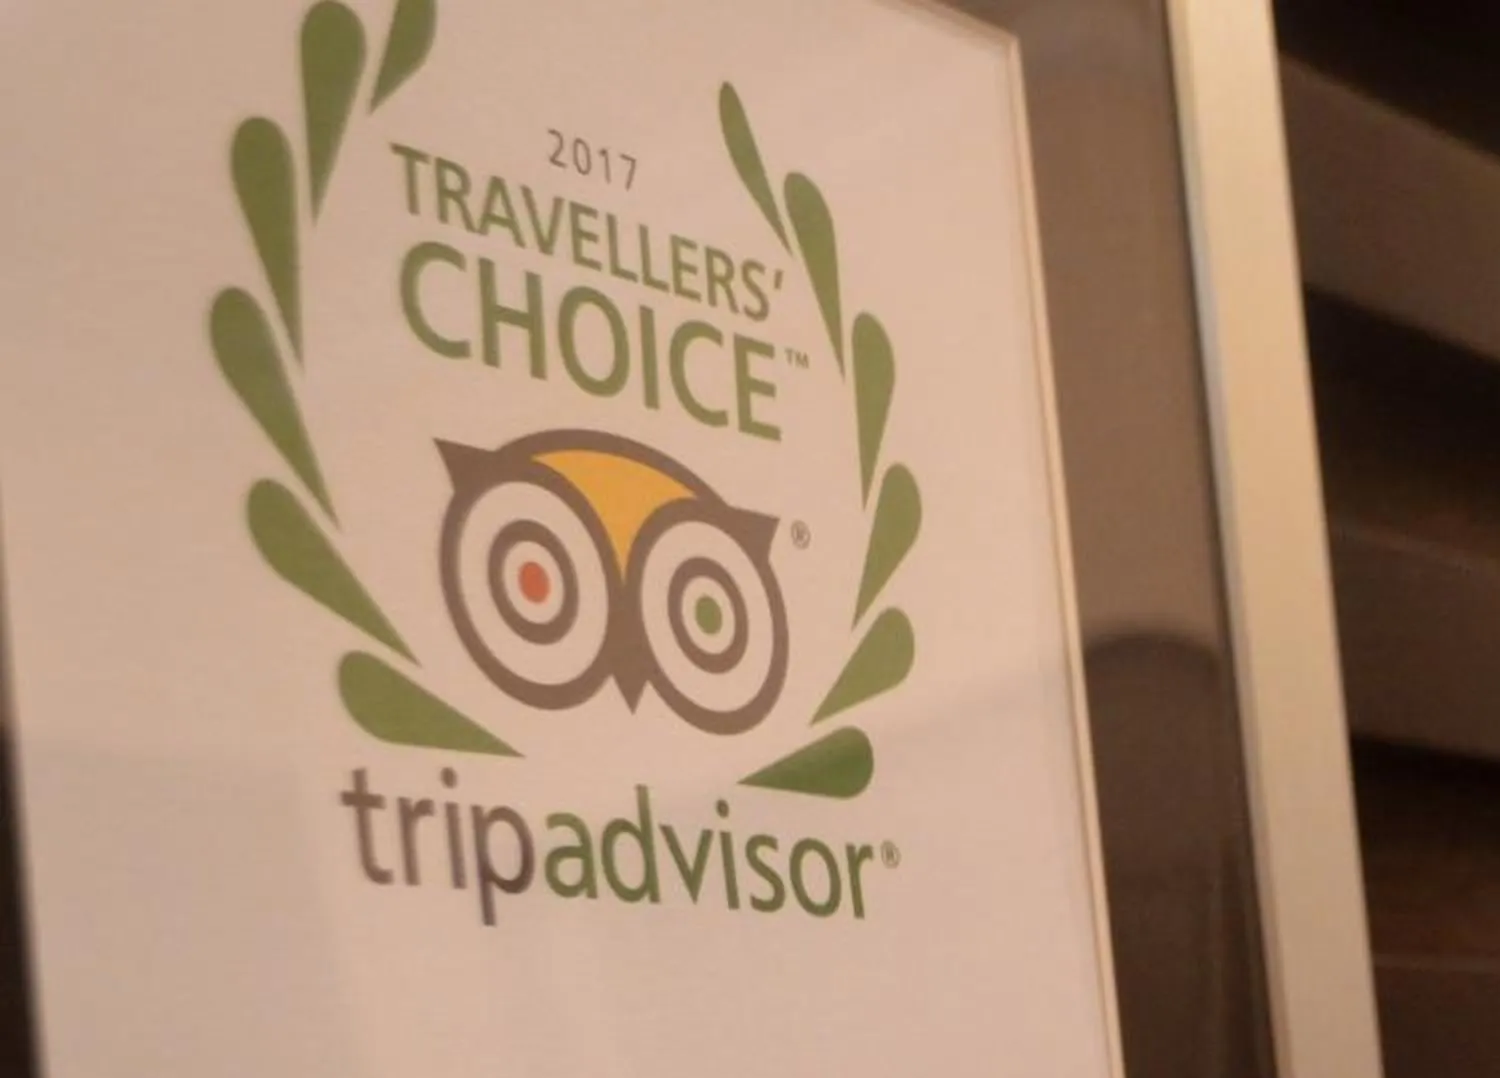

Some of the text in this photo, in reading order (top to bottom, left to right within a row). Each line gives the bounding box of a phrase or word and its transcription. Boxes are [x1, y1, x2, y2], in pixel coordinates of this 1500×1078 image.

[389, 142, 784, 322] TRAVELLERS'
[547, 128, 638, 191] 2017
[400, 241, 782, 443] CHOICE
[339, 767, 874, 926] tripadvisor
